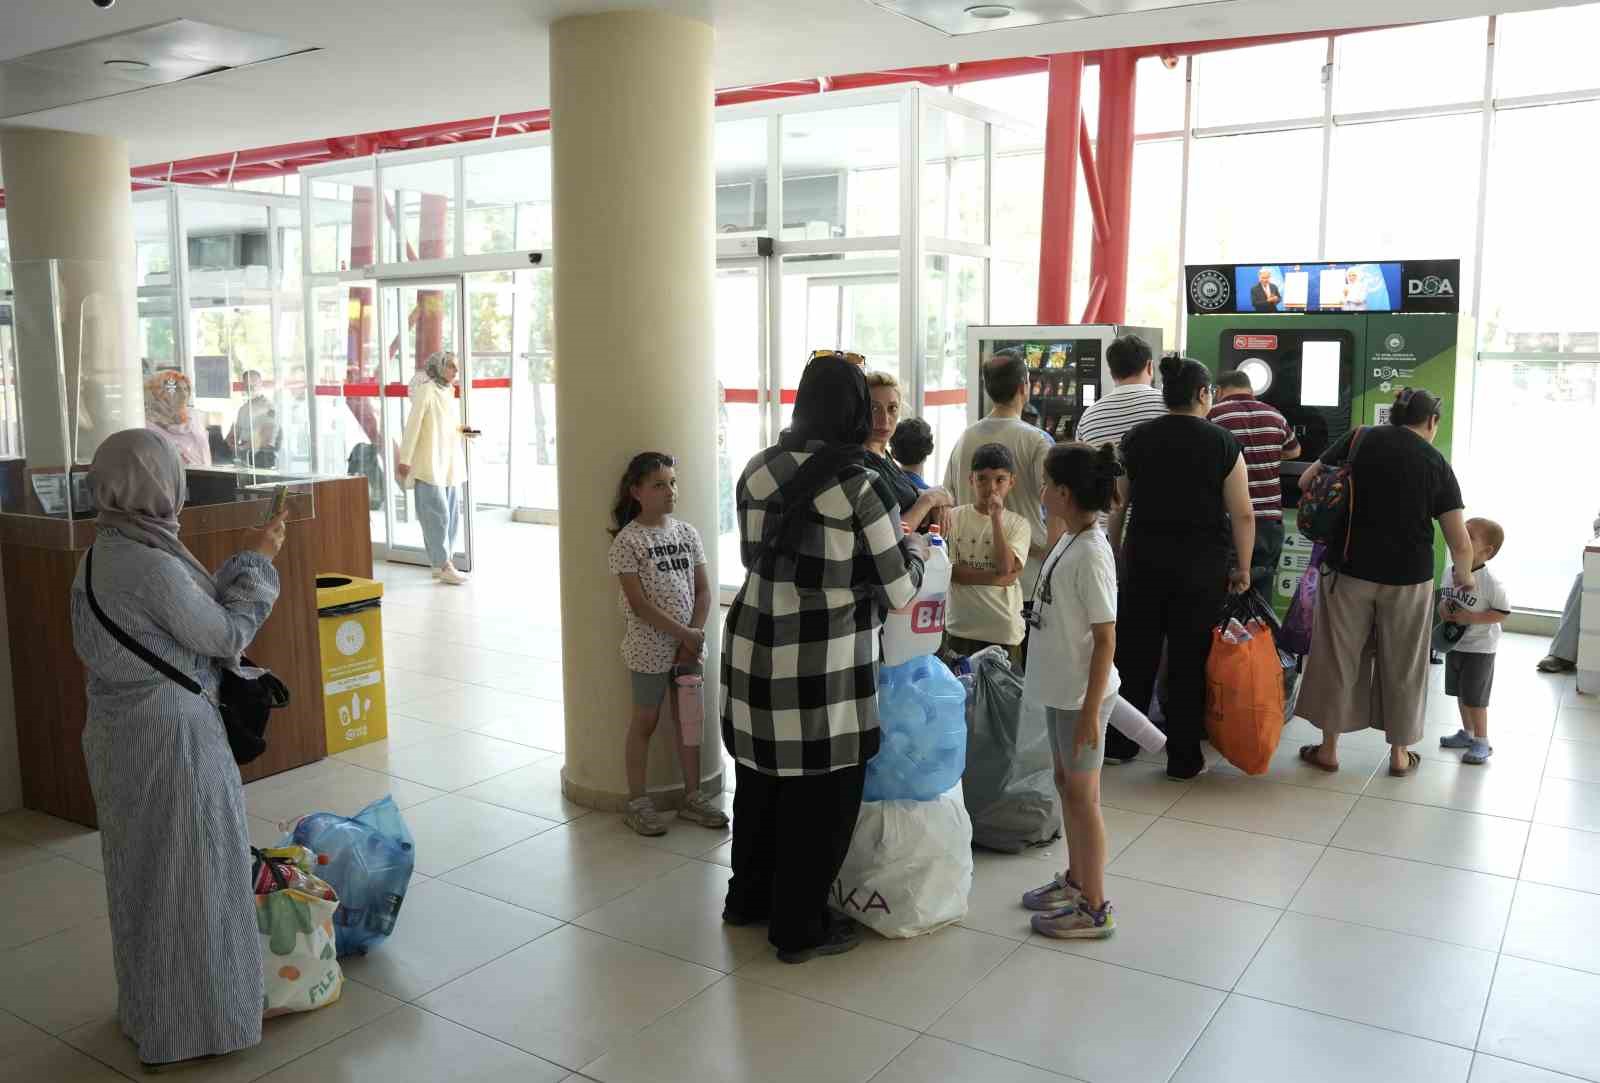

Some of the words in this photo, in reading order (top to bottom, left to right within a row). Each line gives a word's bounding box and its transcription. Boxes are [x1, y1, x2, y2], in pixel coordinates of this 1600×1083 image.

[1284, 536, 1294, 546] 4
[656, 558, 690, 572] CLUB
[1283, 556, 1292, 566] 5
[1281, 579, 1291, 589] 6
